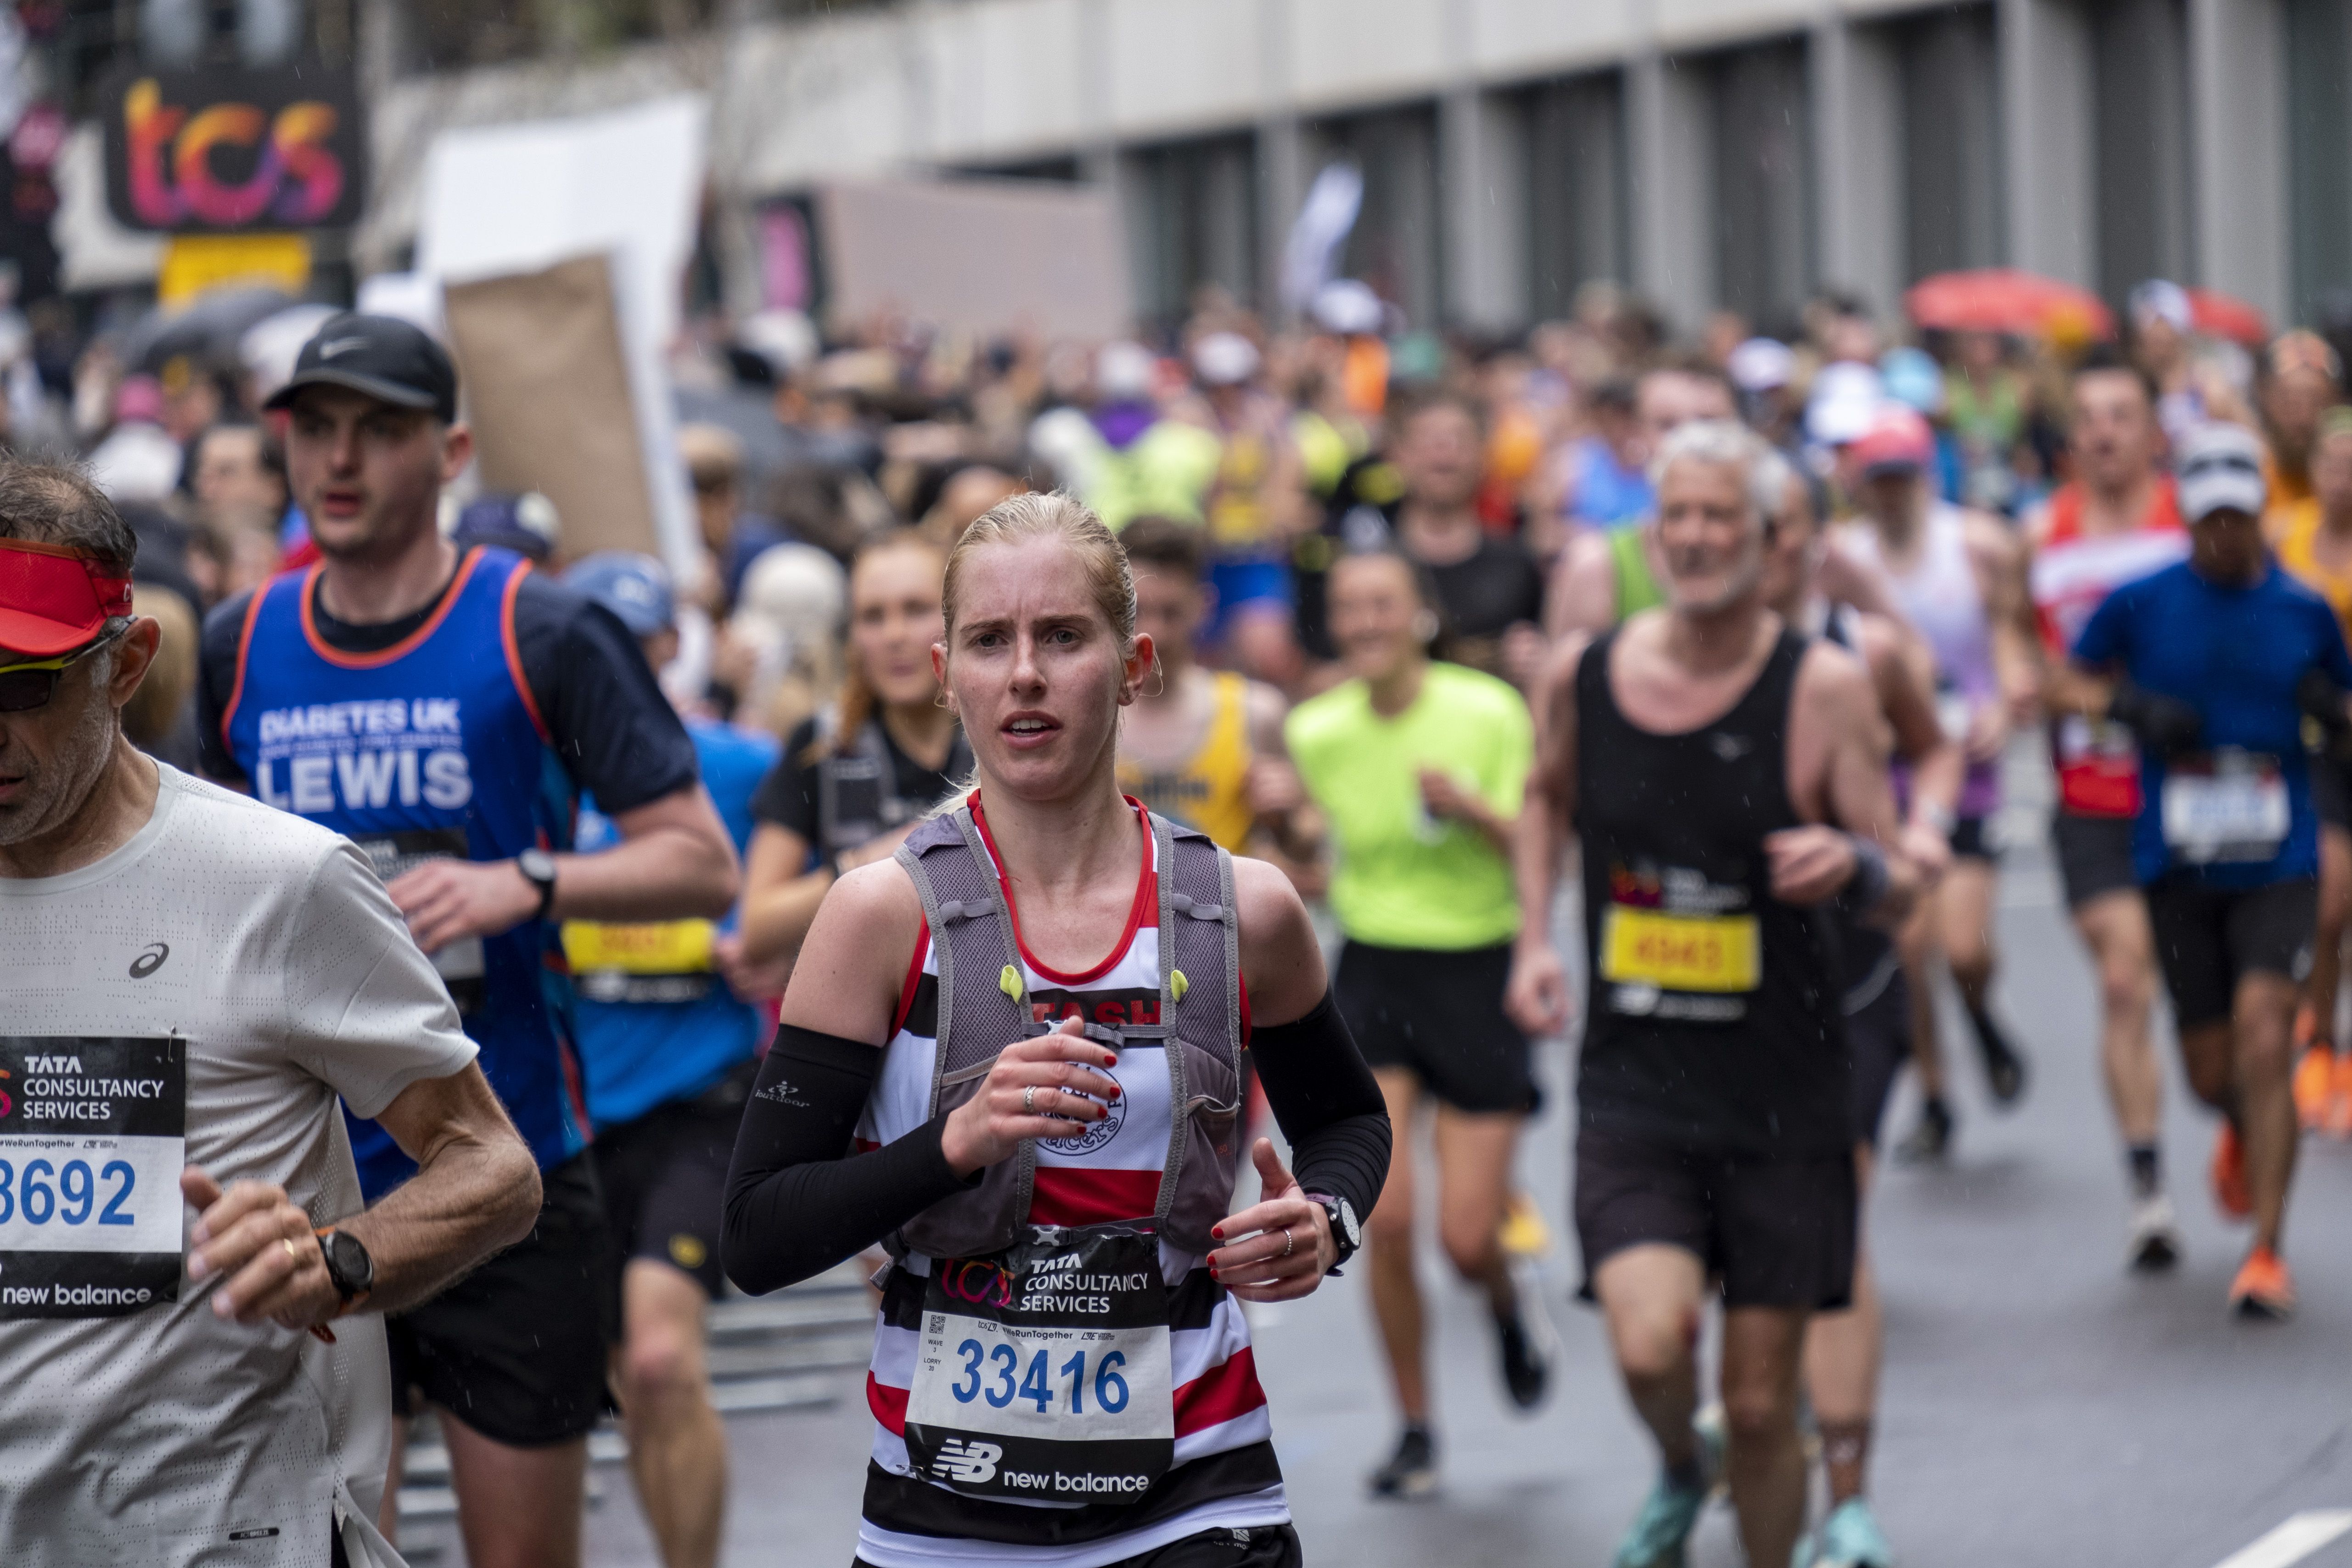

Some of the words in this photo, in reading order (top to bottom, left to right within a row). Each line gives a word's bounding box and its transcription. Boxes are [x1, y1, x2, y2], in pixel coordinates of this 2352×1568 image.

[124, 77, 345, 227] tcs
[259, 698, 408, 742] DIABETES
[412, 698, 461, 733] UK
[256, 748, 473, 814] LEWIS
[24, 1056, 83, 1074] TATA
[23, 1079, 164, 1098] CONSULTANCY
[23, 1102, 111, 1119] SERVICES
[1031, 1253, 1082, 1274] TATA
[942, 1259, 1016, 1309] tcs
[1025, 1273, 1148, 1292] CONSULTANCY
[3, 1287, 49, 1305] new
[55, 1283, 152, 1305] balance
[1020, 1295, 1110, 1313] SERVICES
[951, 1338, 1129, 1414] 33416
[1004, 1471, 1050, 1489] new
[1055, 1471, 1149, 1493] balance
